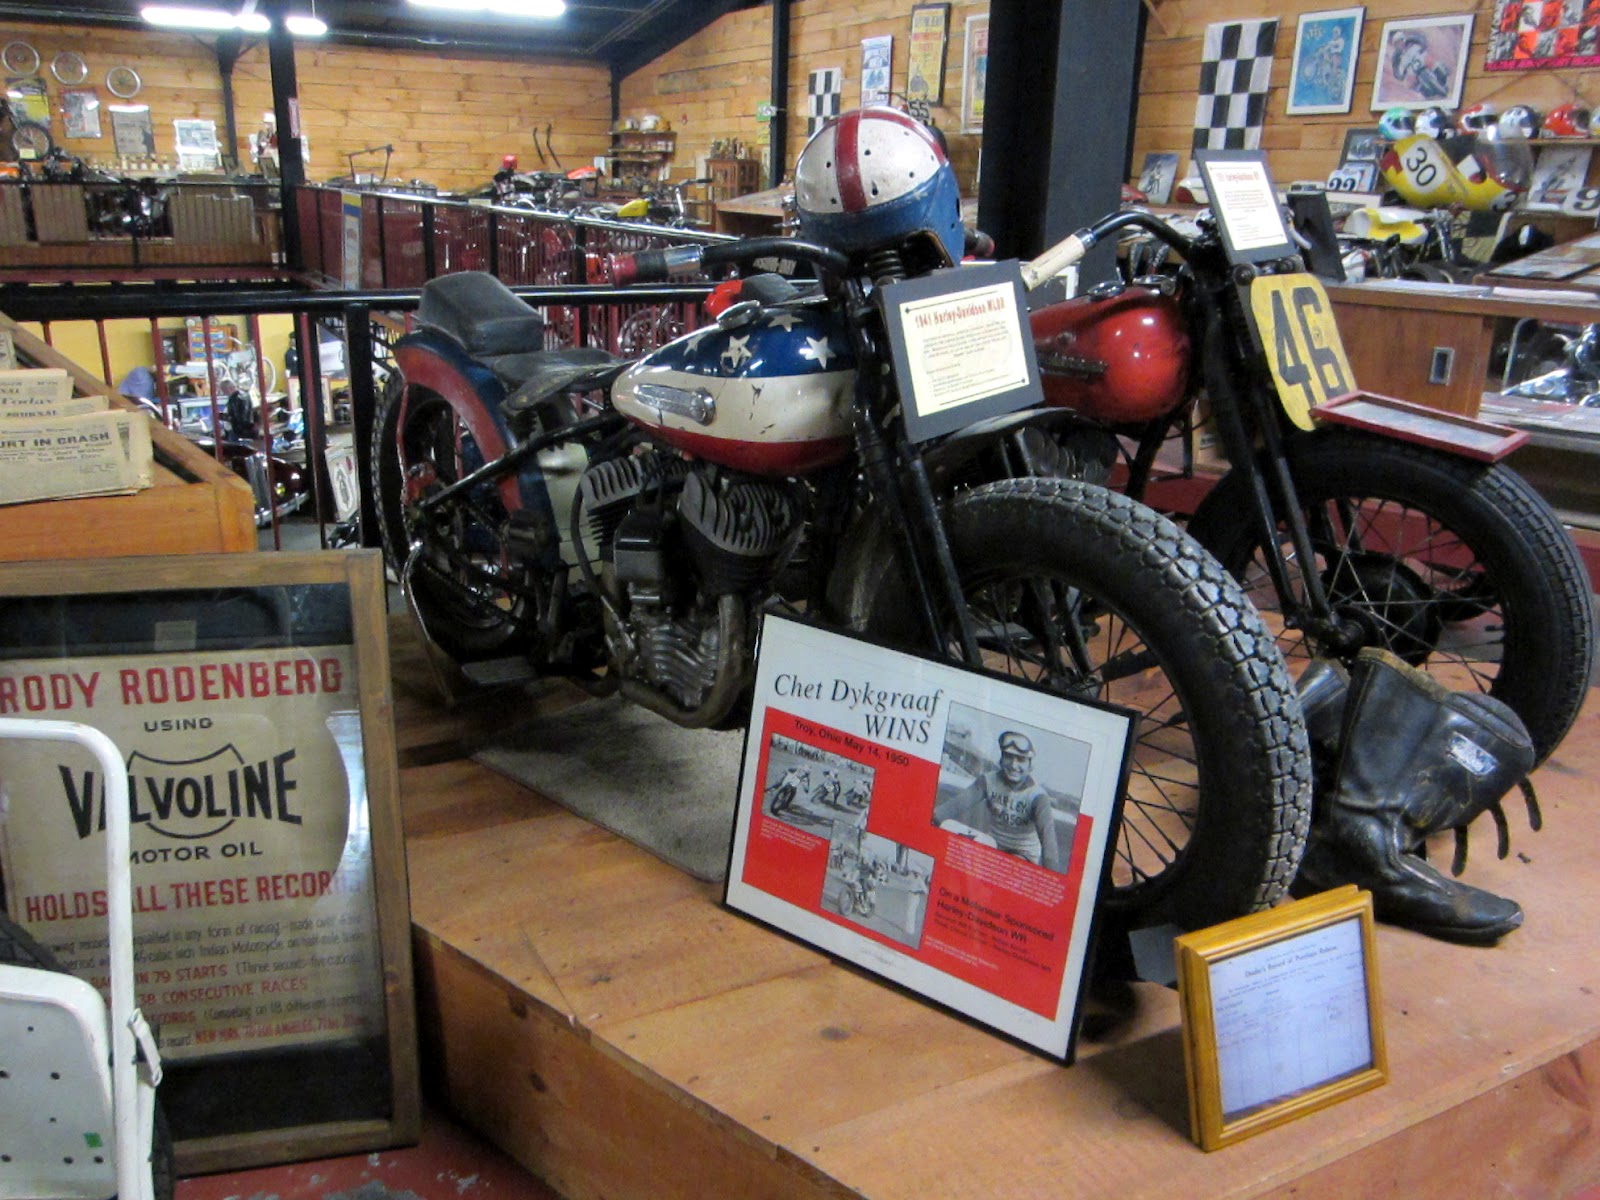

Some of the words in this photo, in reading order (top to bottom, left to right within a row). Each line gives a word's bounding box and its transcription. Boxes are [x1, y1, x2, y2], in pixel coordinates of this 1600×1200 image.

[1406, 147, 1437, 186] 30
[1271, 287, 1349, 408] 46
[33, 438, 52, 446] IN
[57, 431, 110, 445] CRASH
[0, 671, 100, 714] RODY
[119, 658, 343, 705] RODENBERG
[774, 673, 823, 700] Chet
[831, 679, 944, 718] Dykgraaf
[144, 717, 214, 733] USING
[865, 713, 931, 745] WINS
[819, 728, 841, 743] Ohio
[844, 737, 865, 753] May
[886, 751, 910, 767] 1950
[58, 748, 303, 840] VLVOLINE
[221, 841, 264, 859] OIL
[25, 890, 108, 923] HOLDS
[133, 885, 168, 913] LL
[169, 878, 250, 909] THESE
[162, 982, 254, 1004] CONSECUTIVE
[261, 976, 307, 994] RACES
[175, 963, 229, 982] STARTS
